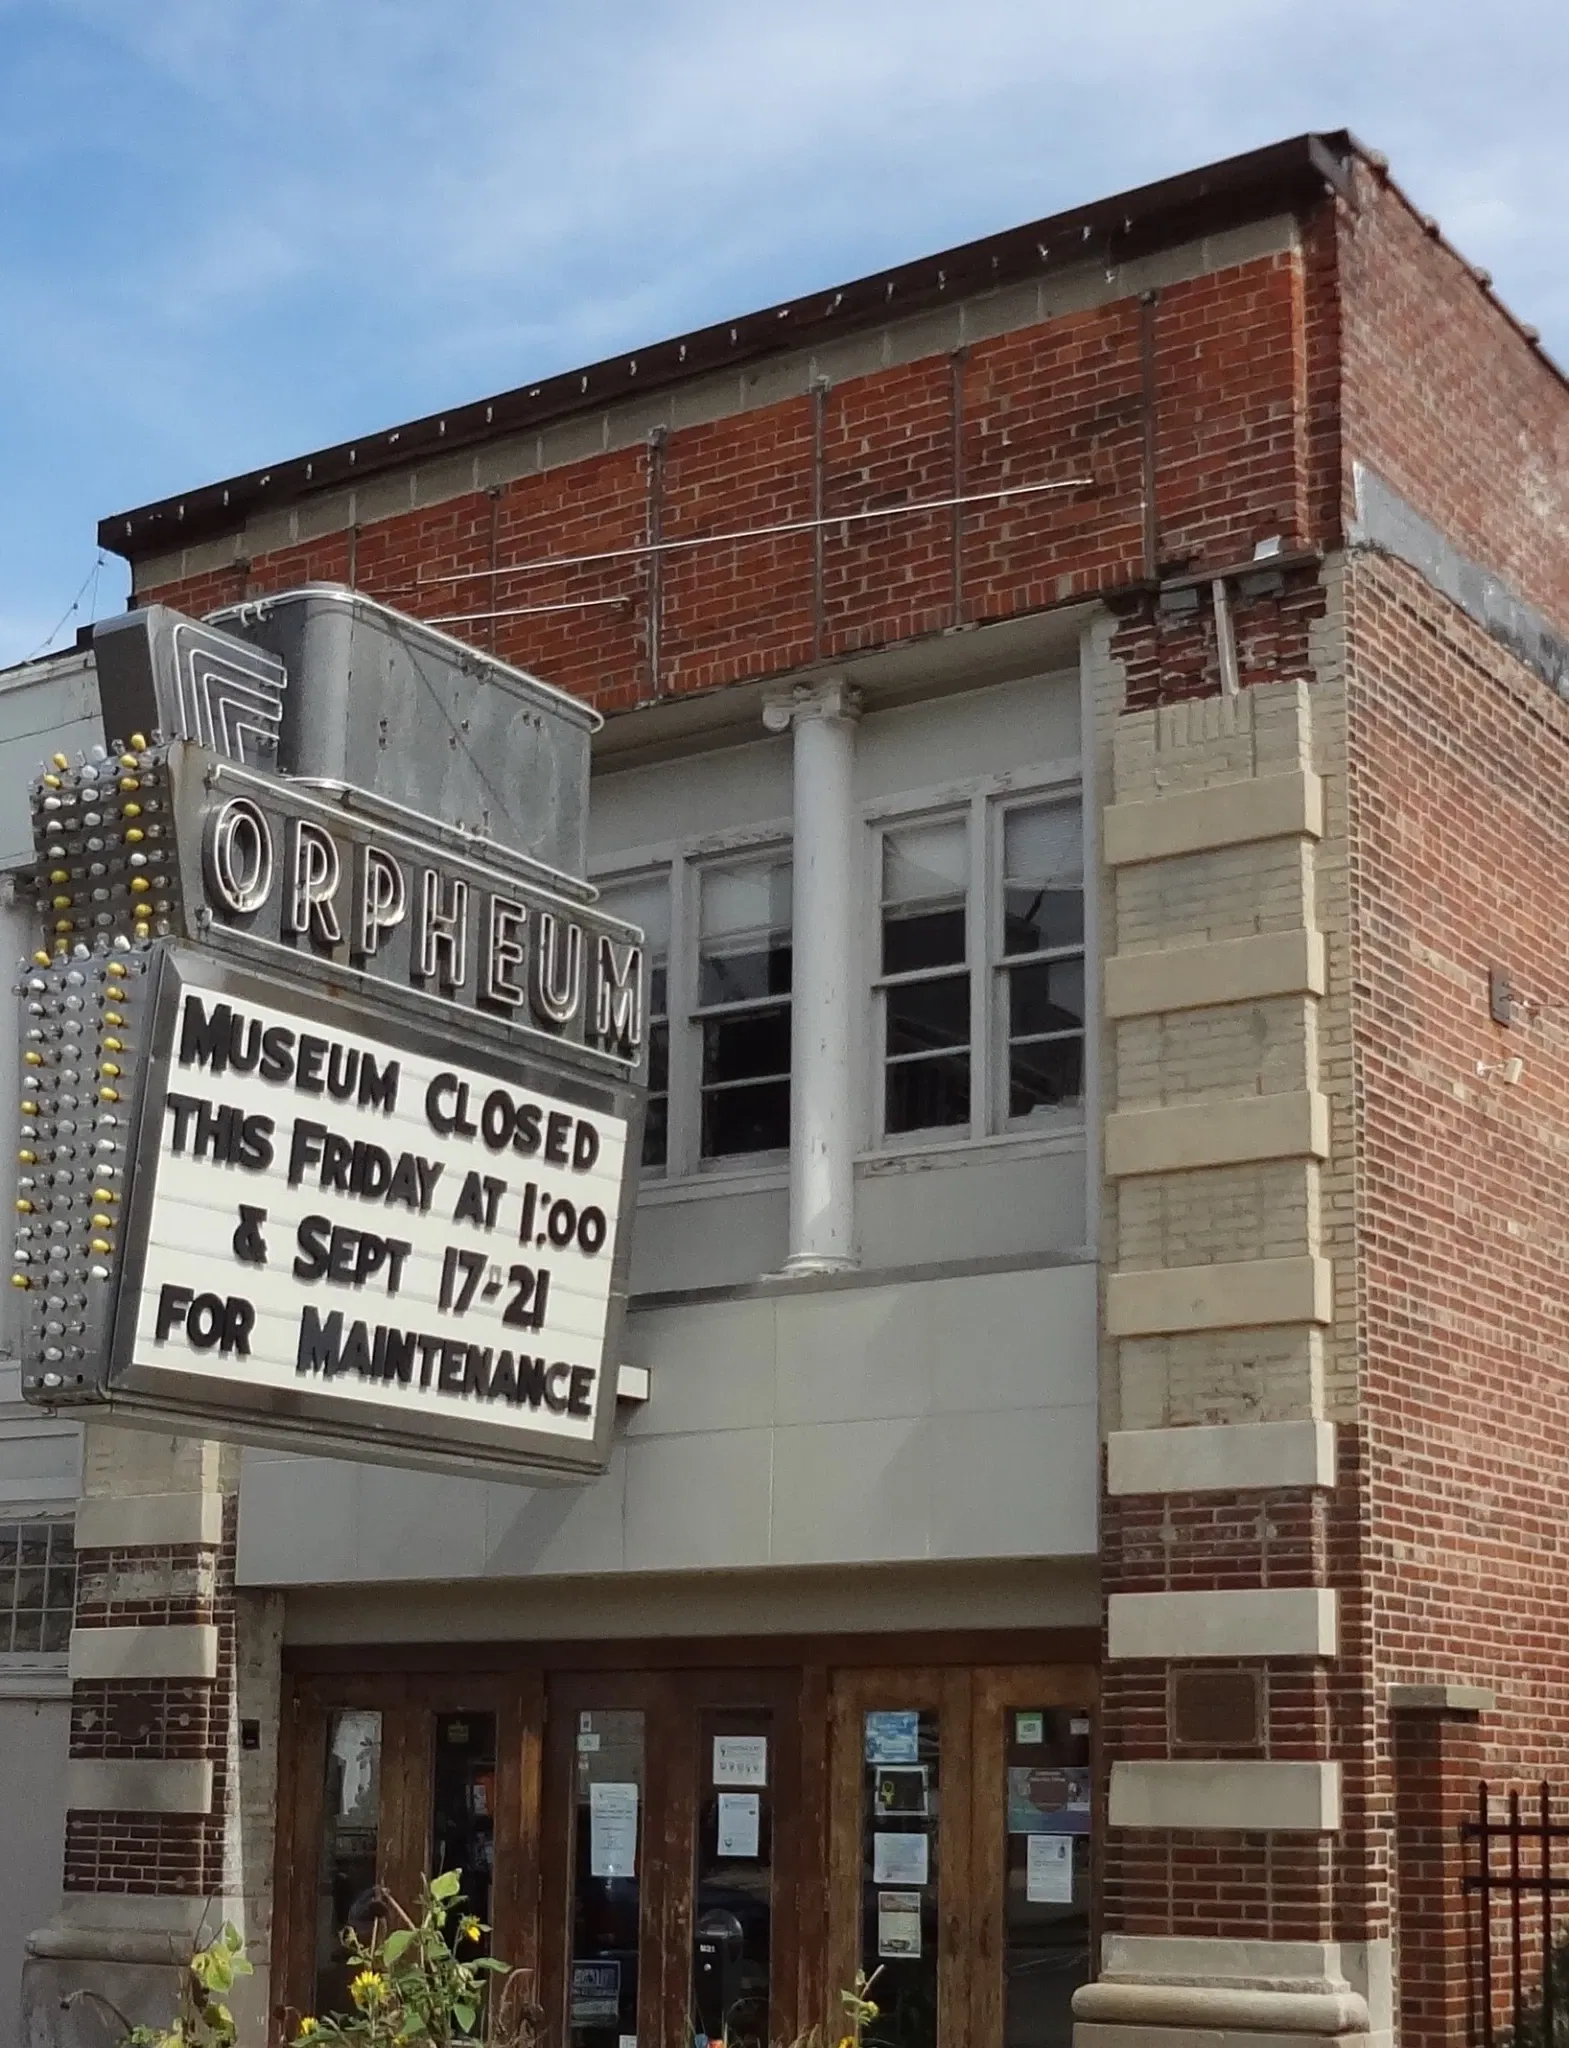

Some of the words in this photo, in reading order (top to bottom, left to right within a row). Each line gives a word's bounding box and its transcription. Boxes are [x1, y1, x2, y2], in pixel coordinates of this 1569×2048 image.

[203, 796, 643, 1045] ORPHEUM
[180, 995, 401, 1113] MUSEUM
[426, 1072, 600, 1170] CLOSED
[167, 1092, 275, 1170] THIS
[288, 1118, 446, 1213] FRIDAY
[453, 1170, 508, 1230] AT
[520, 1182, 606, 1253] 1:00
[233, 1204, 268, 1264] &
[294, 1214, 412, 1293] SEPT
[439, 1246, 550, 1329] 17-21
[156, 1283, 255, 1355] FOR
[296, 1305, 596, 1416] MAINTENANCE
